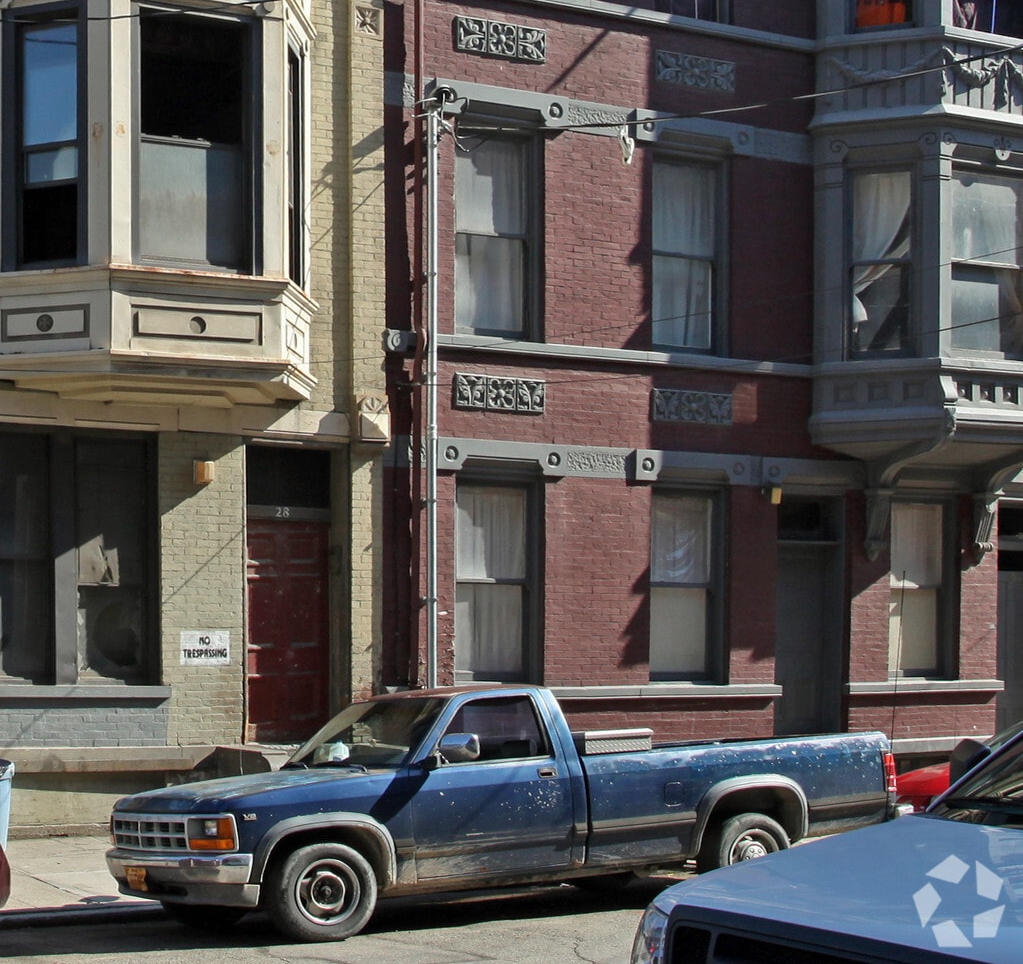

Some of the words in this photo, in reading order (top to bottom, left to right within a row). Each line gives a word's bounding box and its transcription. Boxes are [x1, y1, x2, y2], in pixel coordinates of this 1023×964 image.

[275, 506, 290, 518] 28
[198, 636, 211, 646] NO
[182, 648, 228, 658] TRESPASSING
